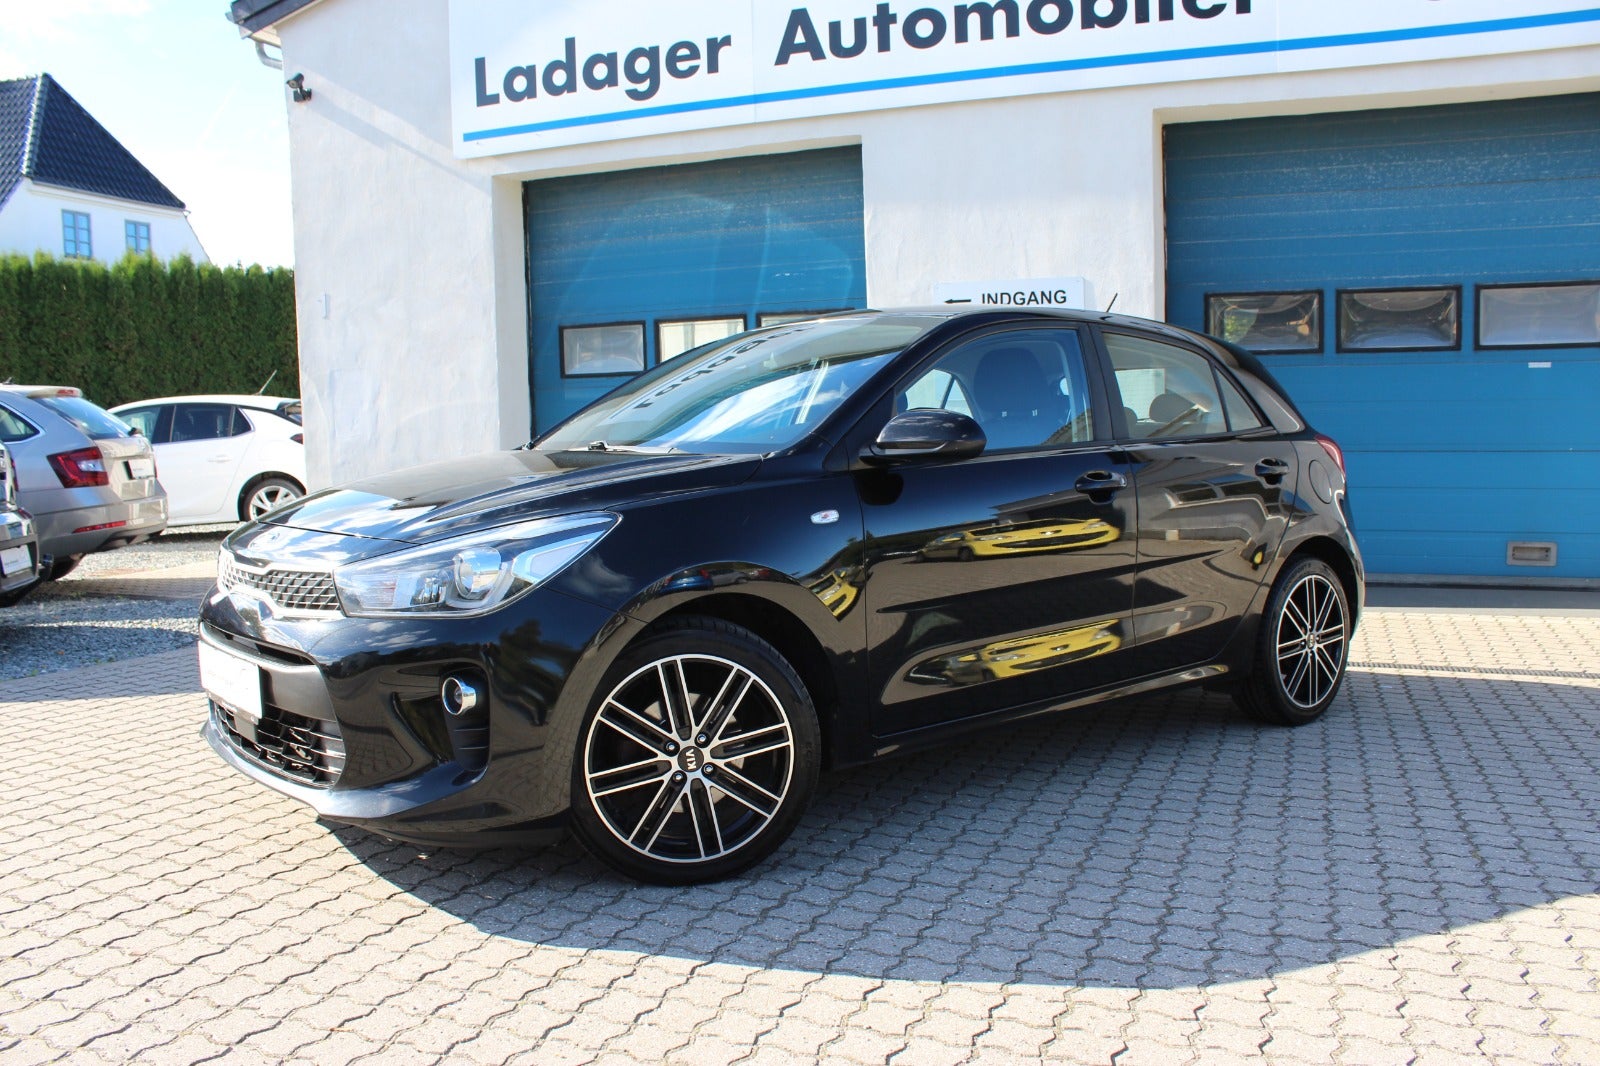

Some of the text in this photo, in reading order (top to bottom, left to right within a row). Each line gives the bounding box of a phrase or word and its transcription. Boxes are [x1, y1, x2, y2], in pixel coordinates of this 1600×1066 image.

[475, 35, 732, 107] Ladager
[982, 289, 1067, 306] INDGANG
[685, 748, 697, 770] KIA
